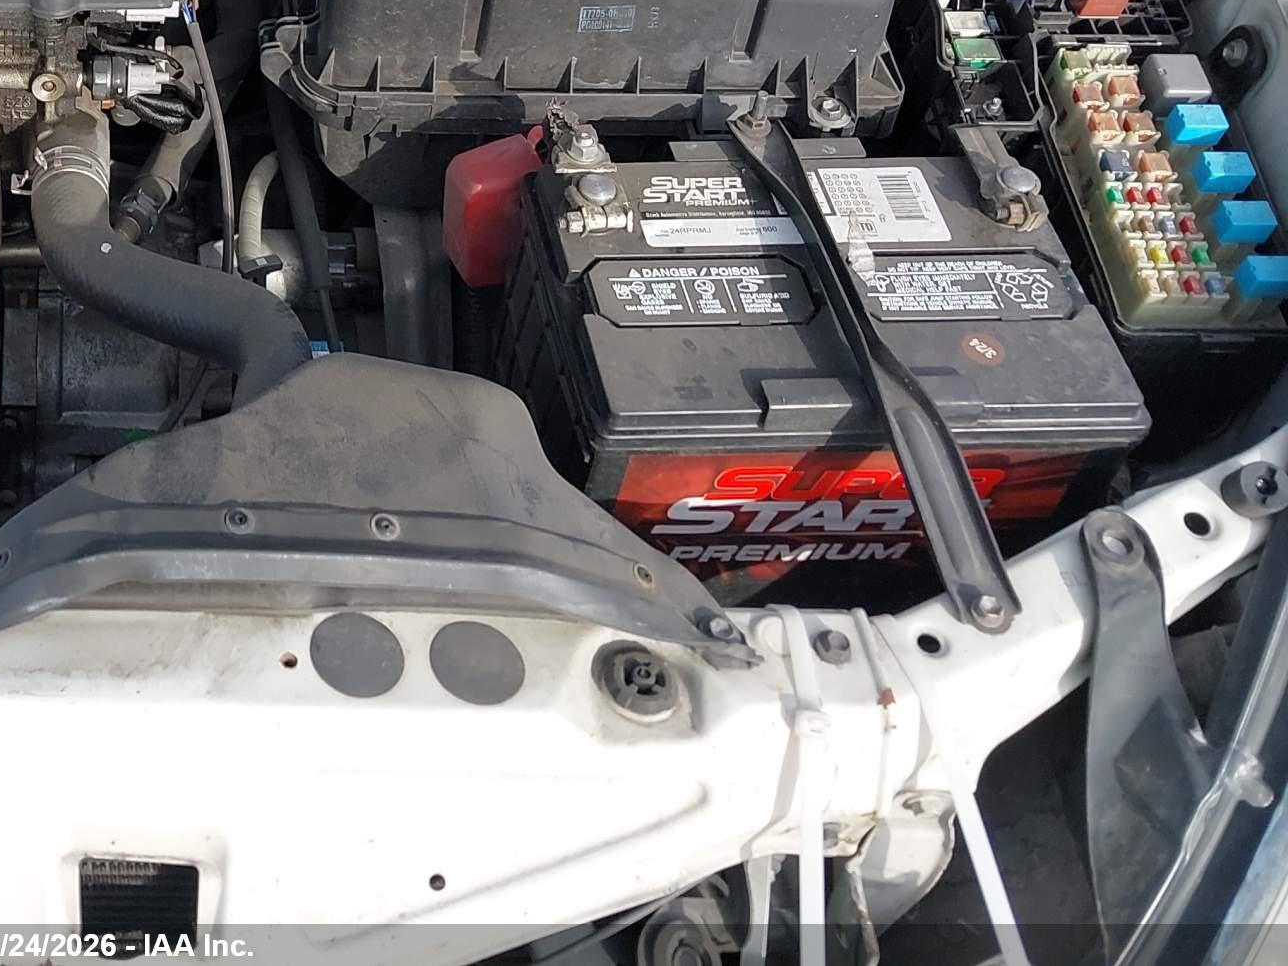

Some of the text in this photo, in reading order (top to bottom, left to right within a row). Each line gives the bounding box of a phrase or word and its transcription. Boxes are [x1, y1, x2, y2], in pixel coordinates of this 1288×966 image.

[650, 176, 743, 190] SUPER
[642, 188, 746, 203] START
[642, 268, 697, 278] DANGER
[711, 266, 760, 276] POISON
[650, 496, 915, 535] STAR
[674, 541, 913, 564] PREMIUM
